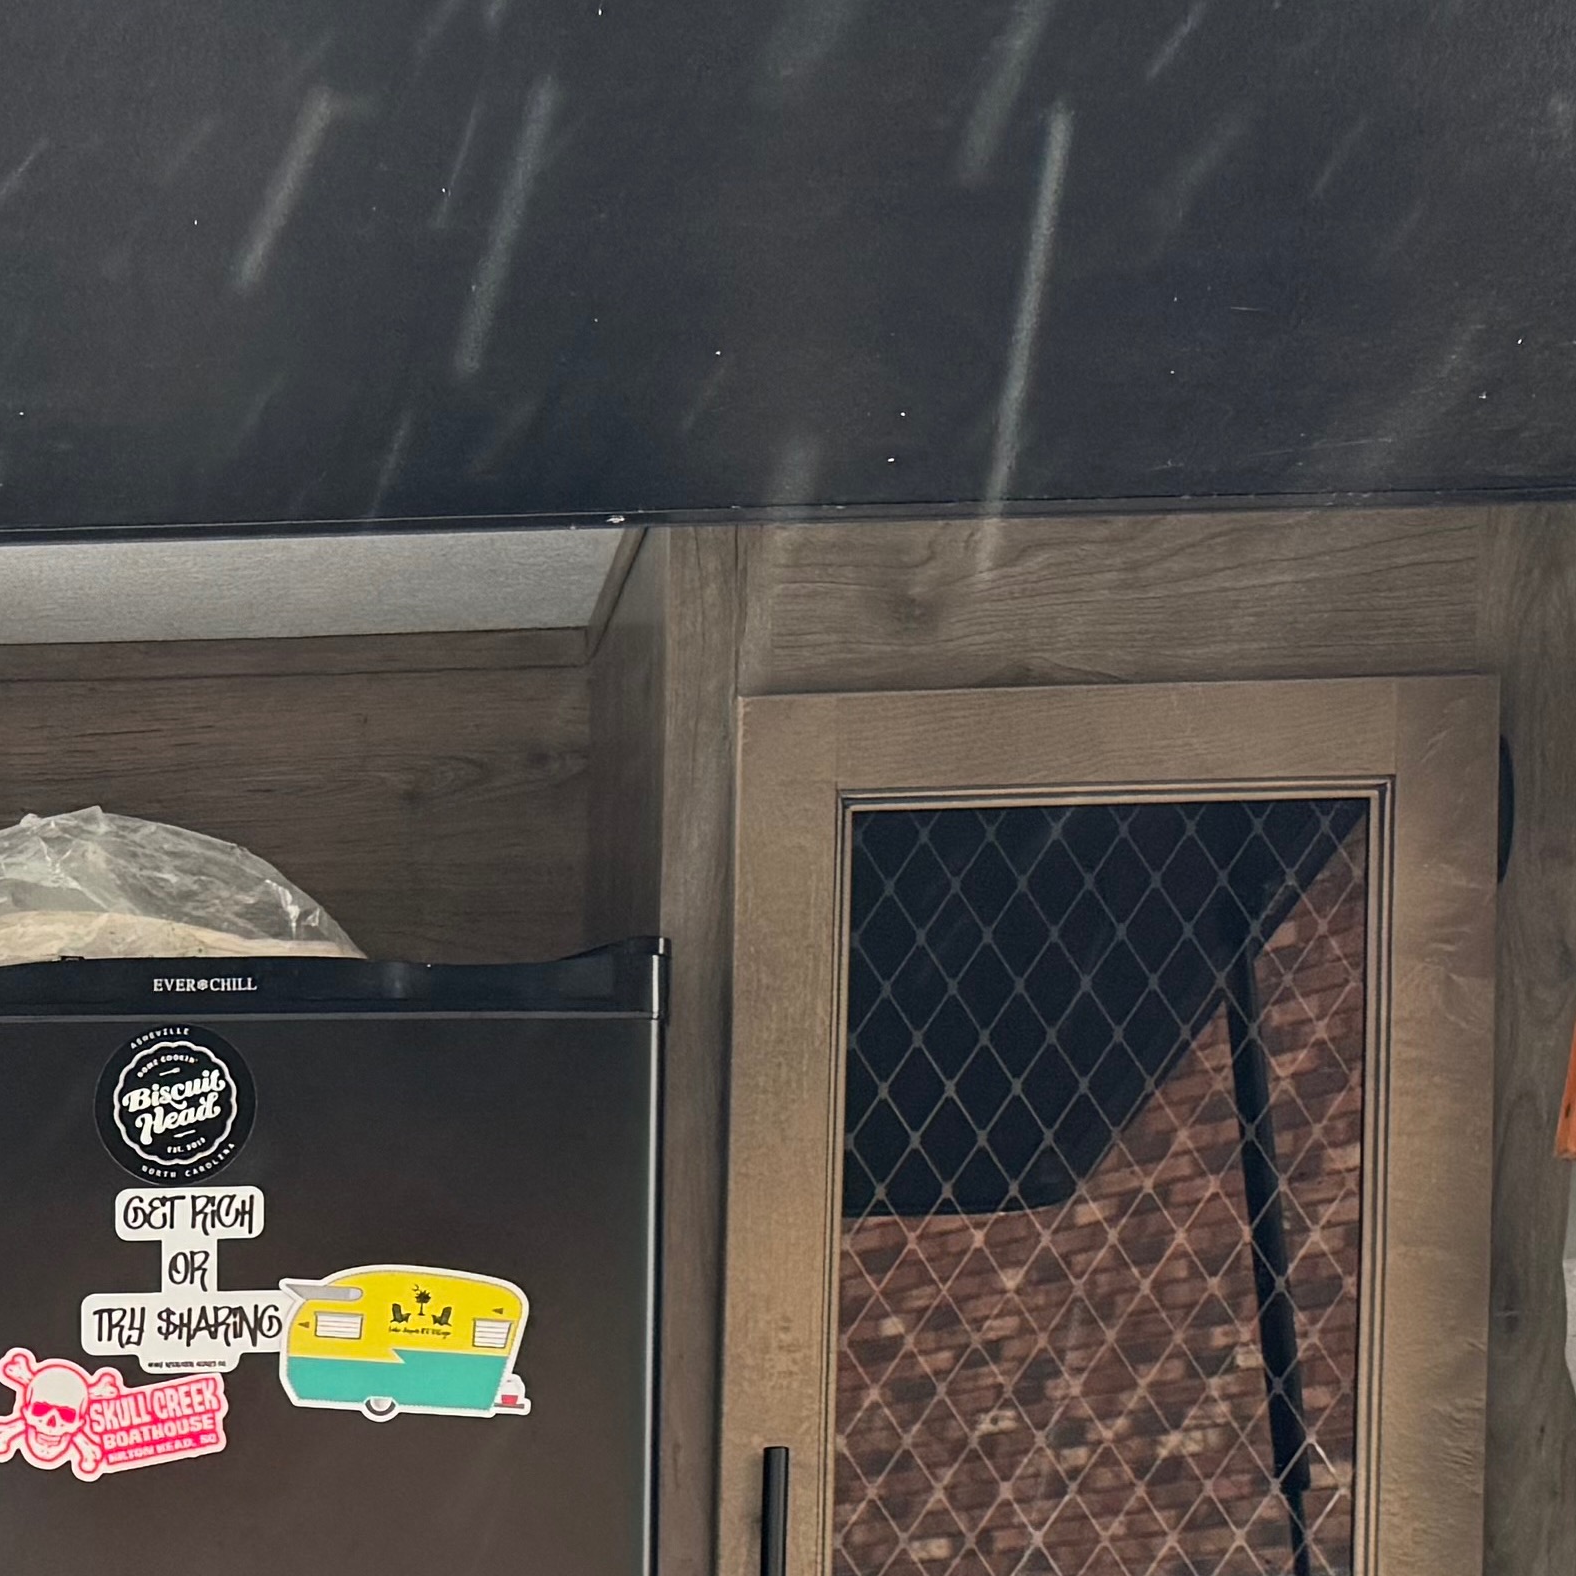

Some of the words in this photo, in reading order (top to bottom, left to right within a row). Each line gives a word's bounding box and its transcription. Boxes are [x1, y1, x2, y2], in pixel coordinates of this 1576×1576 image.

[130, 1027, 190, 1050] ASHEVILLE
[122, 1069, 226, 1112] Biscuit
[134, 1092, 222, 1145] Head
[141, 1164, 177, 1178] NORTH
[184, 1142, 235, 1177] CAROLINA
[123, 1195, 186, 1230] GET
[168, 1250, 210, 1292] OR
[89, 1393, 152, 1433] SKULL
[152, 1379, 220, 1420] CREEK
[103, 1413, 215, 1450] BOATHOUSE
